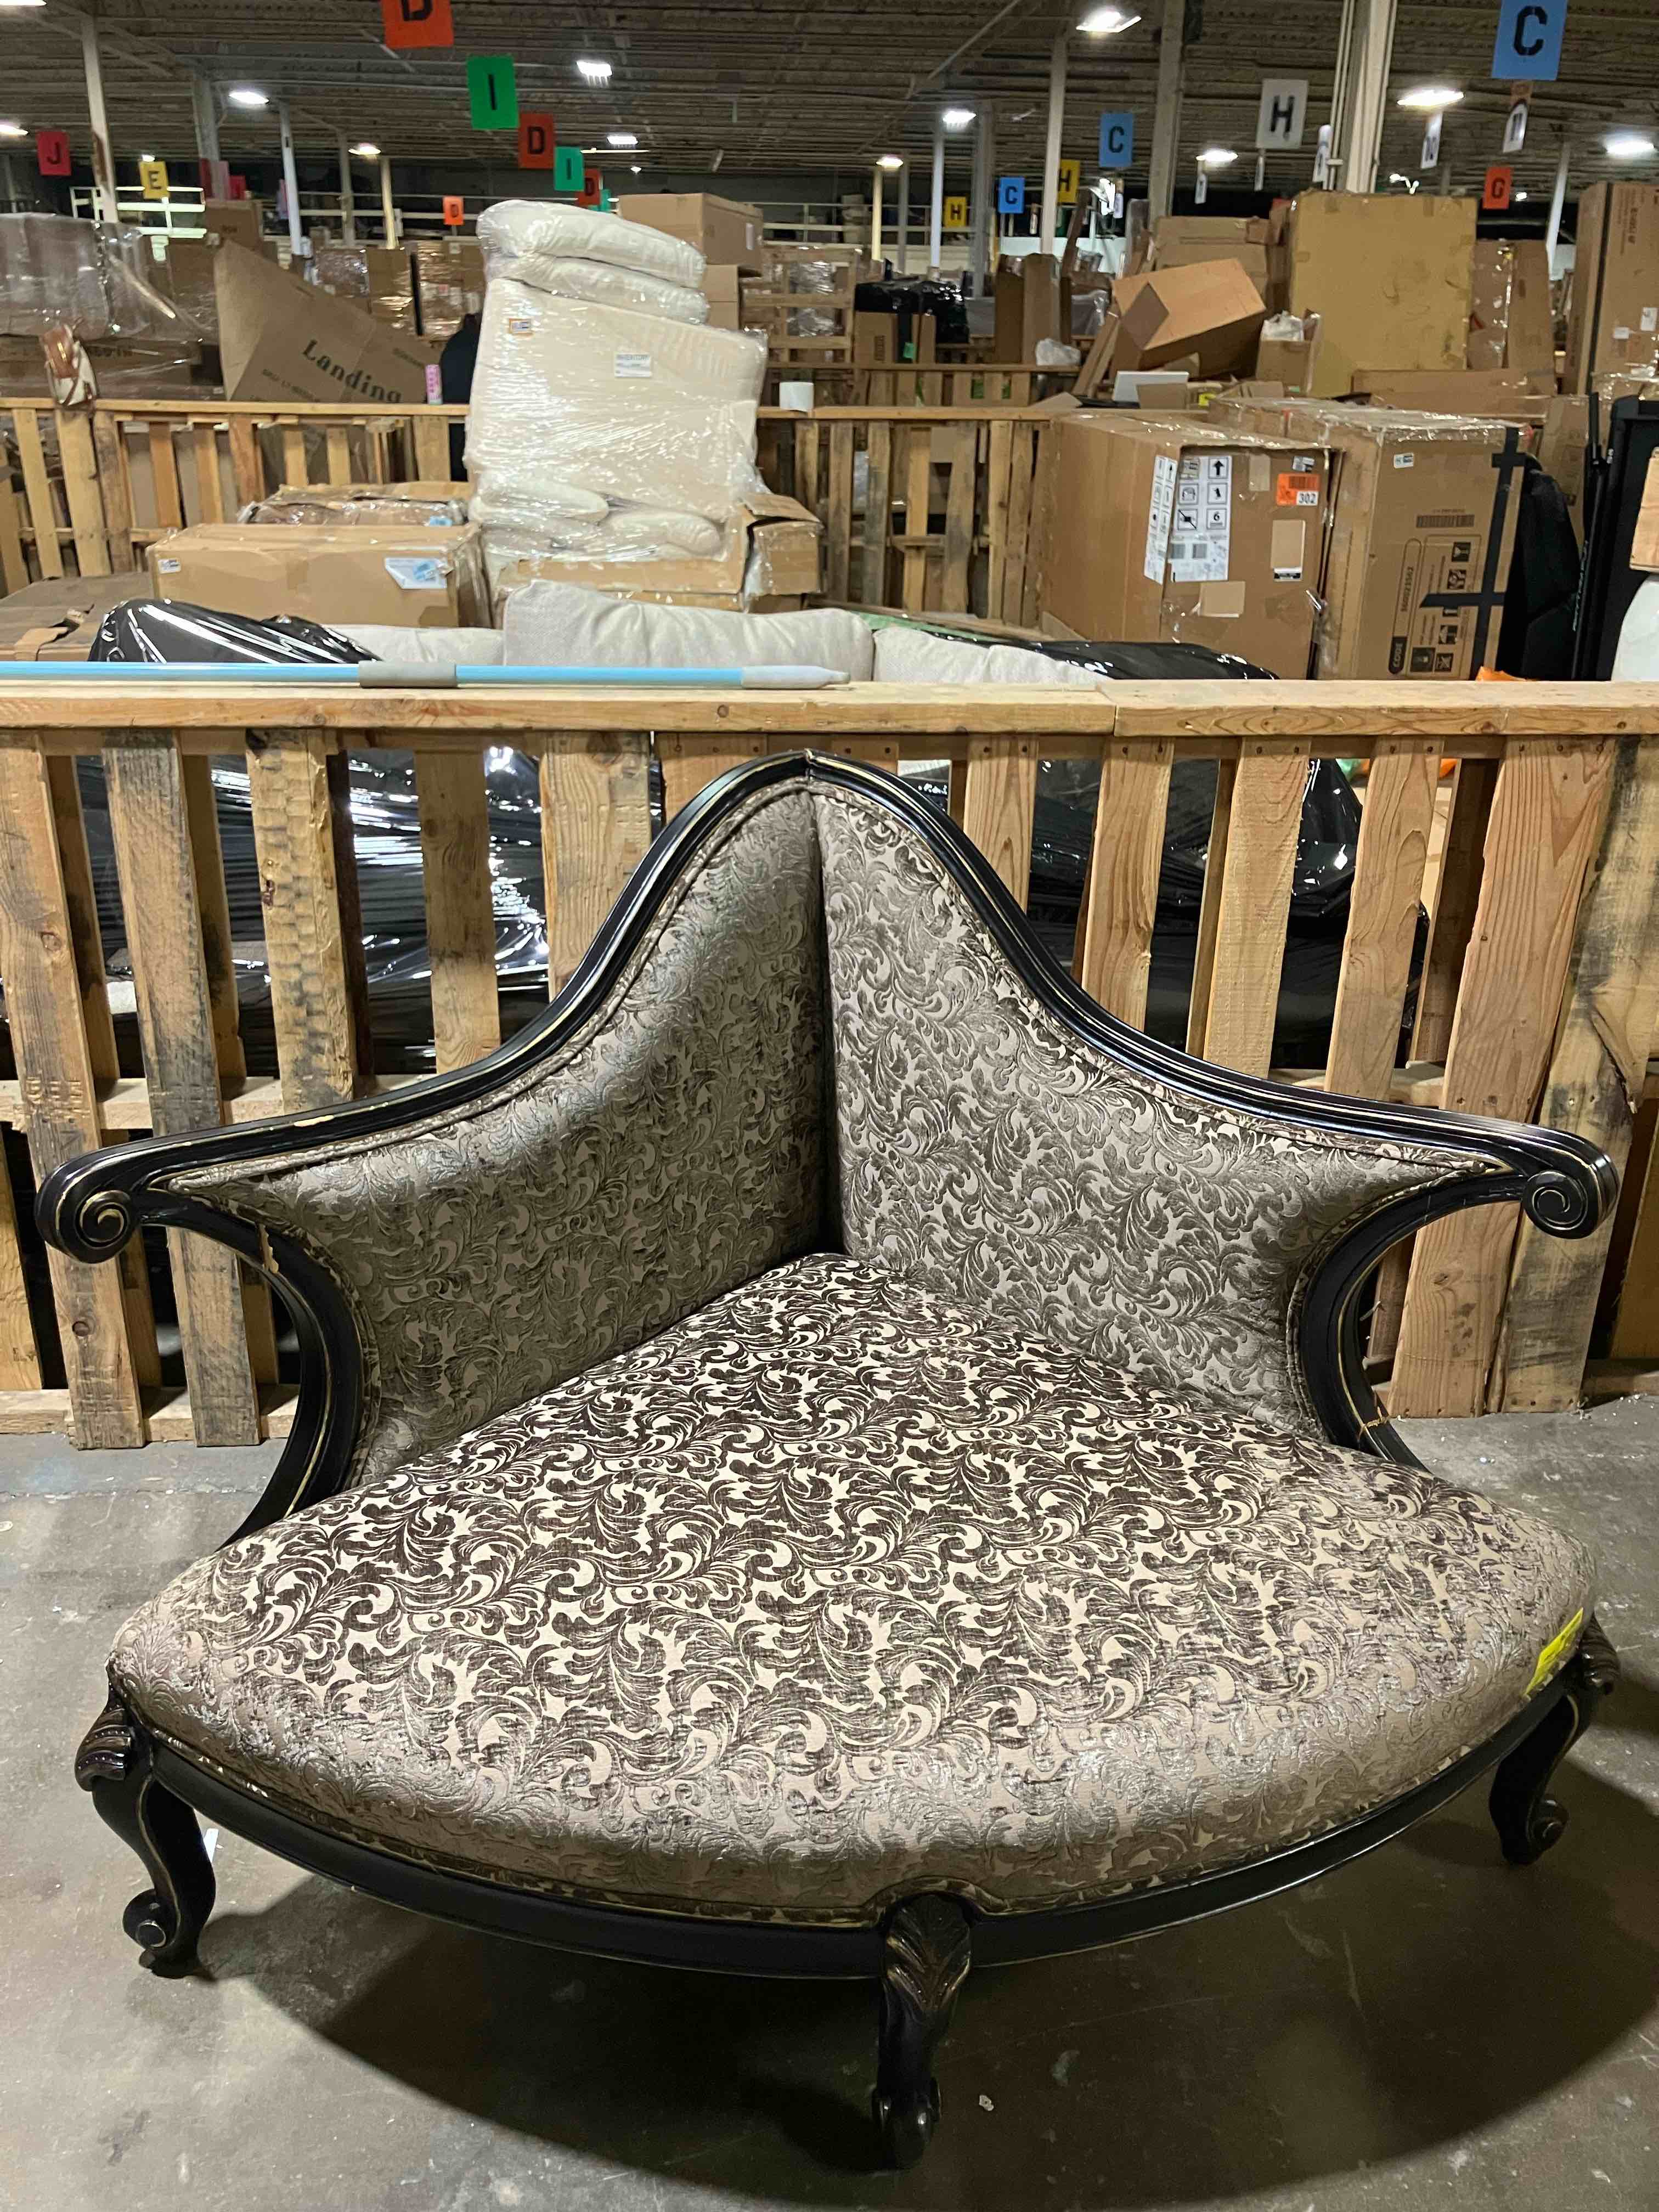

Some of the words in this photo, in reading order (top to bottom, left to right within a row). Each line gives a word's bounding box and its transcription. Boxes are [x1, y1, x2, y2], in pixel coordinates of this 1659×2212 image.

[1514, 5, 1547, 56] C
[488, 74, 497, 110] I
[1270, 95, 1295, 132] H
[527, 127, 545, 154] D
[1109, 126, 1124, 153] C
[47, 142, 61, 165] J
[149, 171, 162, 189] E
[566, 158, 571, 180] I
[1059, 169, 1071, 192] H
[1005, 186, 1017, 204] C
[951, 205, 962, 219] H
[302, 339, 402, 403] Landing
[1214, 511, 1220, 521] 6
